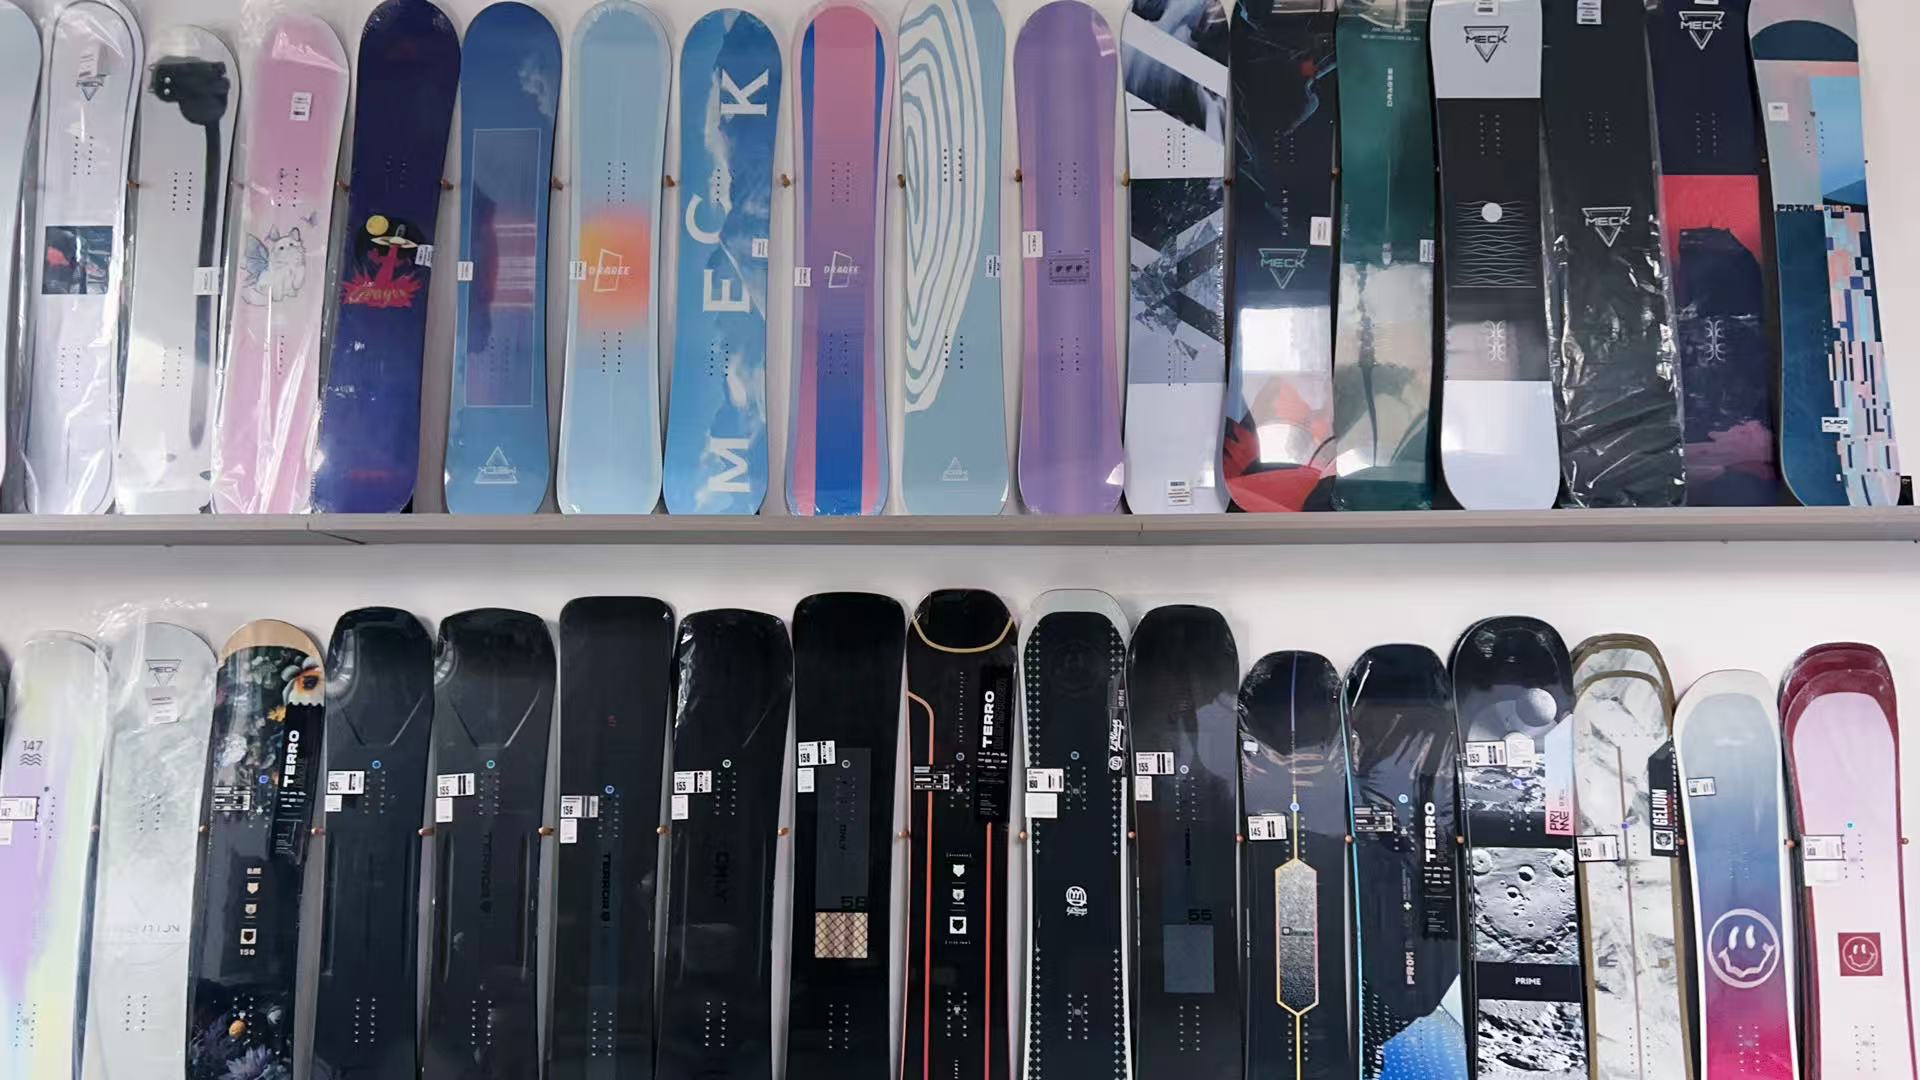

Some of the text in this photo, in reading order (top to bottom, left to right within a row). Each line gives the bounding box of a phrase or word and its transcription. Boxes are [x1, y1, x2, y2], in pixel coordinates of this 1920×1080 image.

[1680, 21, 1723, 30] MECK
[1465, 35, 1508, 44] MECK
[1585, 216, 1630, 227] MECK
[1261, 258, 1305, 269] MECK
[982, 690, 995, 749] TERRO
[23, 740, 43, 751] 147
[283, 729, 300, 788] TERRO
[1651, 788, 1669, 827] GELIUM
[1423, 801, 1437, 863] TERRO
[1514, 976, 1542, 986] PRIME
